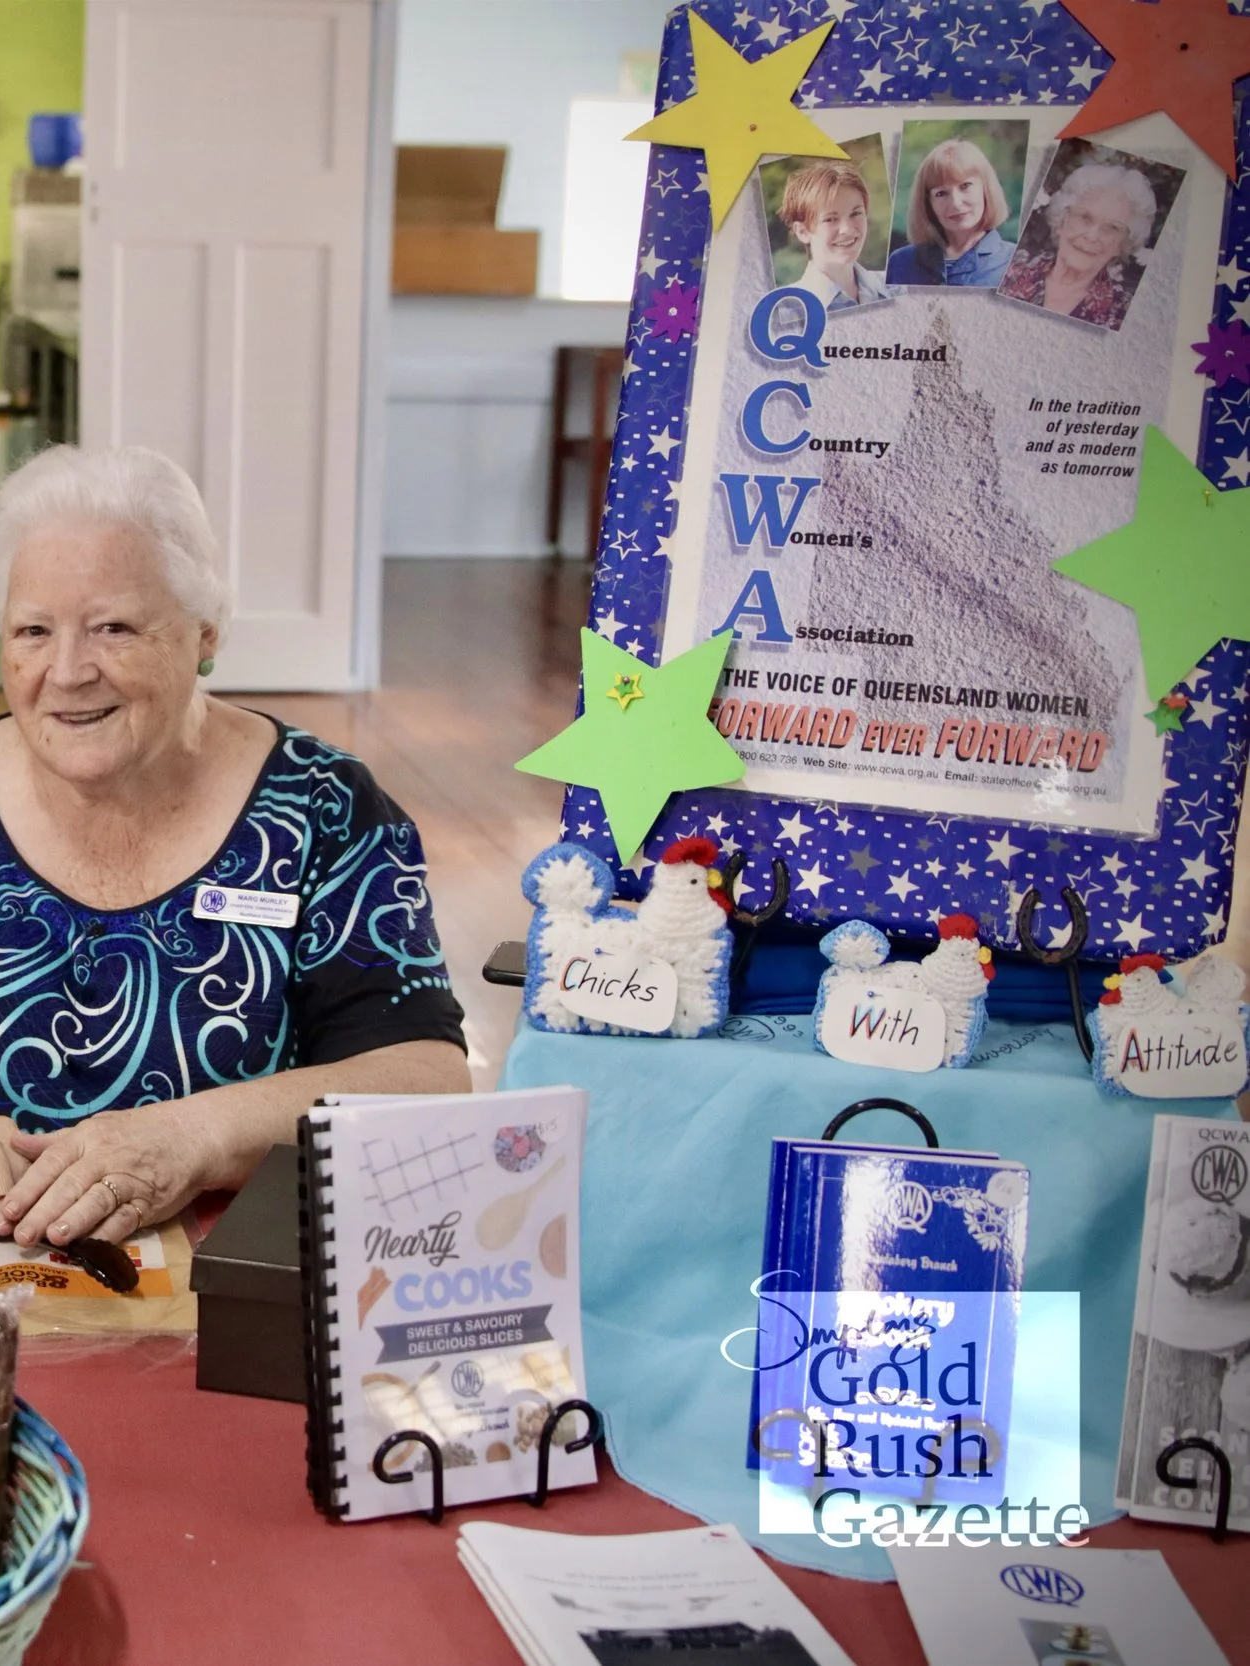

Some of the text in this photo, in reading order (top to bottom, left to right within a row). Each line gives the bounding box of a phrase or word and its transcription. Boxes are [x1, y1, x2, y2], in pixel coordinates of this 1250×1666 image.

[749, 287, 948, 369] Queensland
[741, 379, 890, 459] Country
[1028, 397, 1142, 416] In the tradition
[1046, 418, 1139, 440] of yesterday
[1025, 439, 1137, 457] and as modern
[1040, 460, 1135, 478] as tomorrow
[718, 473, 873, 548] Women's
[711, 569, 915, 647] Association
[723, 667, 1091, 718] THE VOICE OF QUEENSLAND WOMEN
[736, 750, 757, 761] 800
[759, 752, 778, 763] 623
[780, 754, 798, 765] 736
[803, 756, 825, 767] Web
[827, 759, 851, 771] Site:
[944, 769, 978, 784] Email:
[861, 719, 930, 758] EVER
[933, 715, 1110, 773] FORWARD
[560, 956, 658, 1002] Chicks
[849, 1001, 920, 1046] With
[1121, 1027, 1238, 1074] Attitude
[394, 1260, 533, 1313] COOKS
[406, 1313, 524, 1340] SWEET & SAVOURY
[408, 1328, 524, 1356] DELICIOUS SLICES
